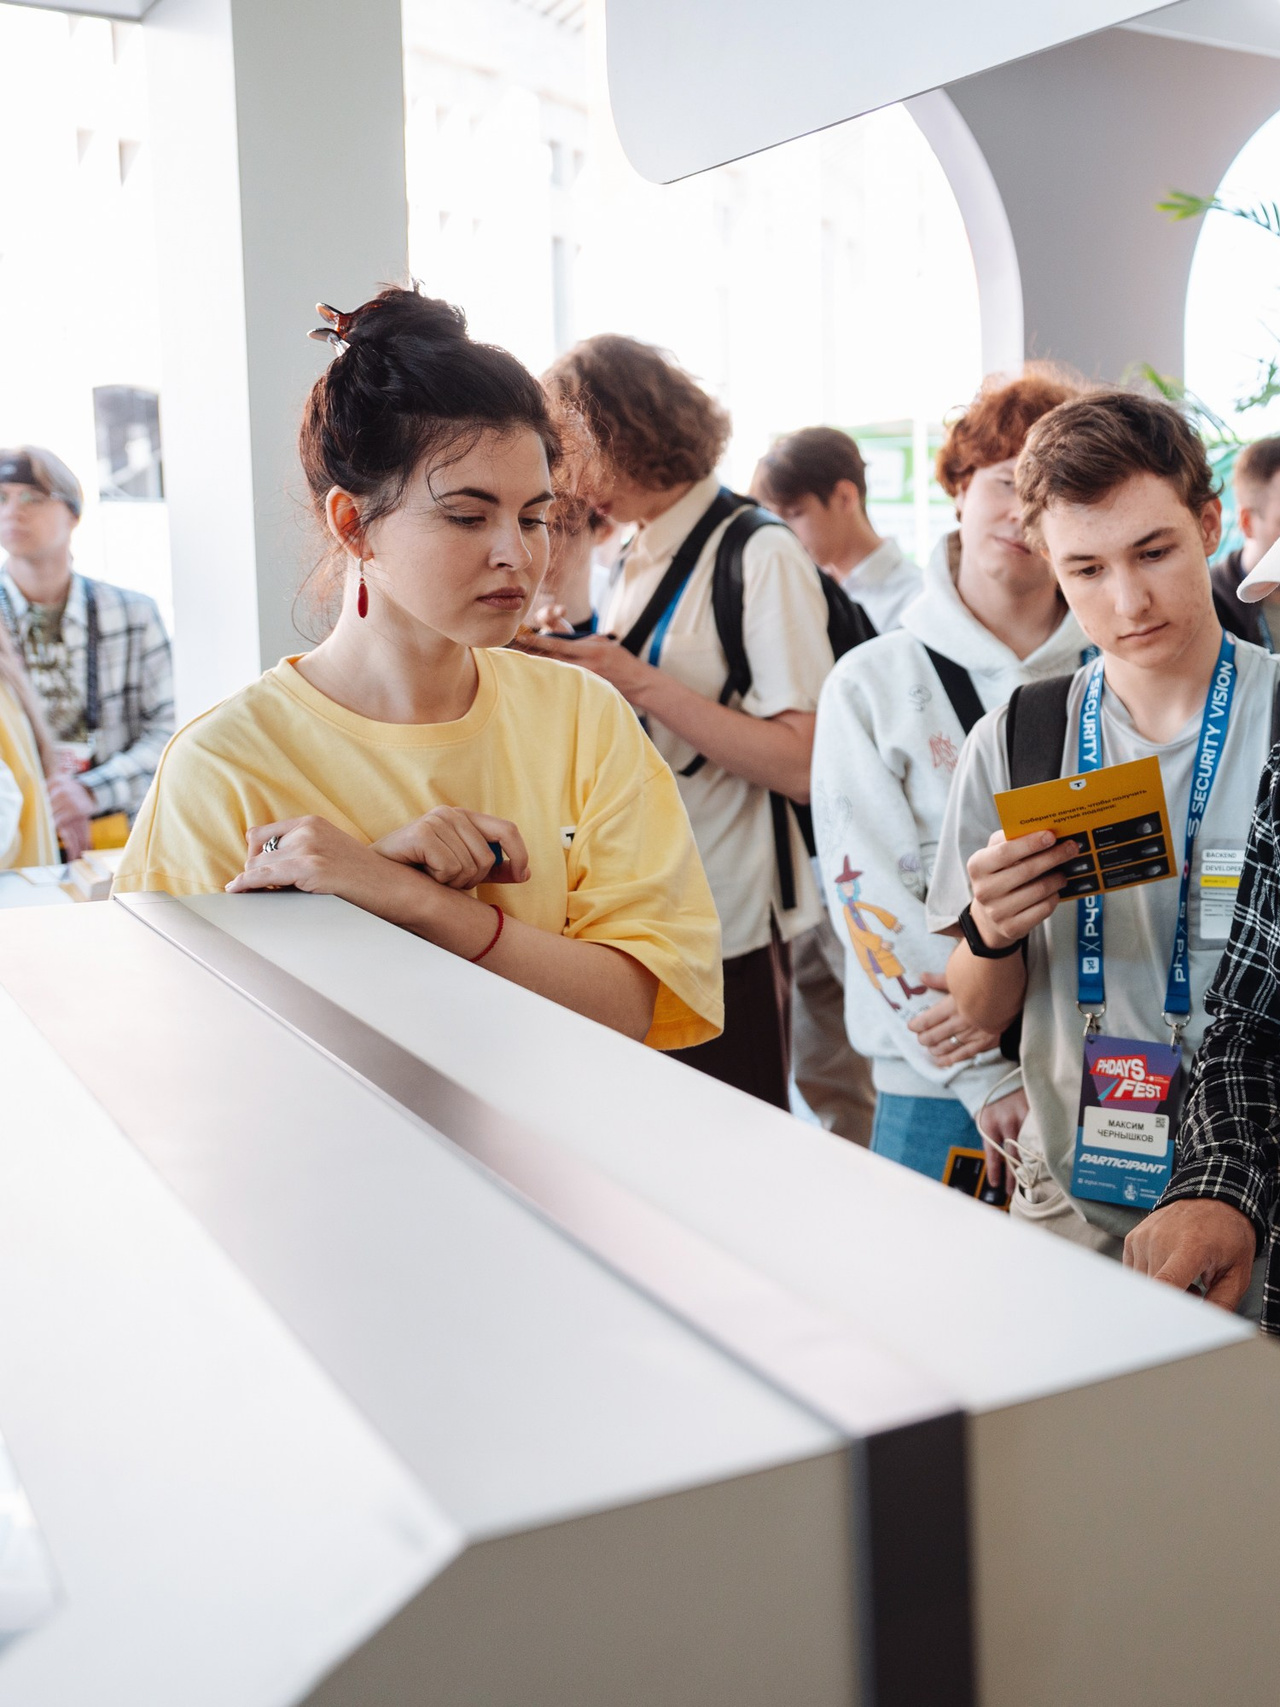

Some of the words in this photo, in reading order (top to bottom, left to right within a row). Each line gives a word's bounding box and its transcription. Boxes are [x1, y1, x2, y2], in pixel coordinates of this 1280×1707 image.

[1082, 678, 1100, 764] SECURITY
[1192, 723, 1221, 814] SECURITY
[1209, 660, 1234, 719] VISION
[1020, 812, 1057, 825] Соберите
[1058, 806, 1087, 816] печати,
[1088, 799, 1111, 809] чтобы
[1112, 789, 1147, 802] получить
[1053, 813, 1080, 824] крутые
[1082, 804, 1117, 816] подарки:
[1114, 1079, 1161, 1098] FEST
[1108, 1119, 1144, 1131] МАКСИМ
[1098, 1129, 1154, 1143] ЧЕРНЫШКОВ
[1079, 1153, 1167, 1174] PARTICIPANT
